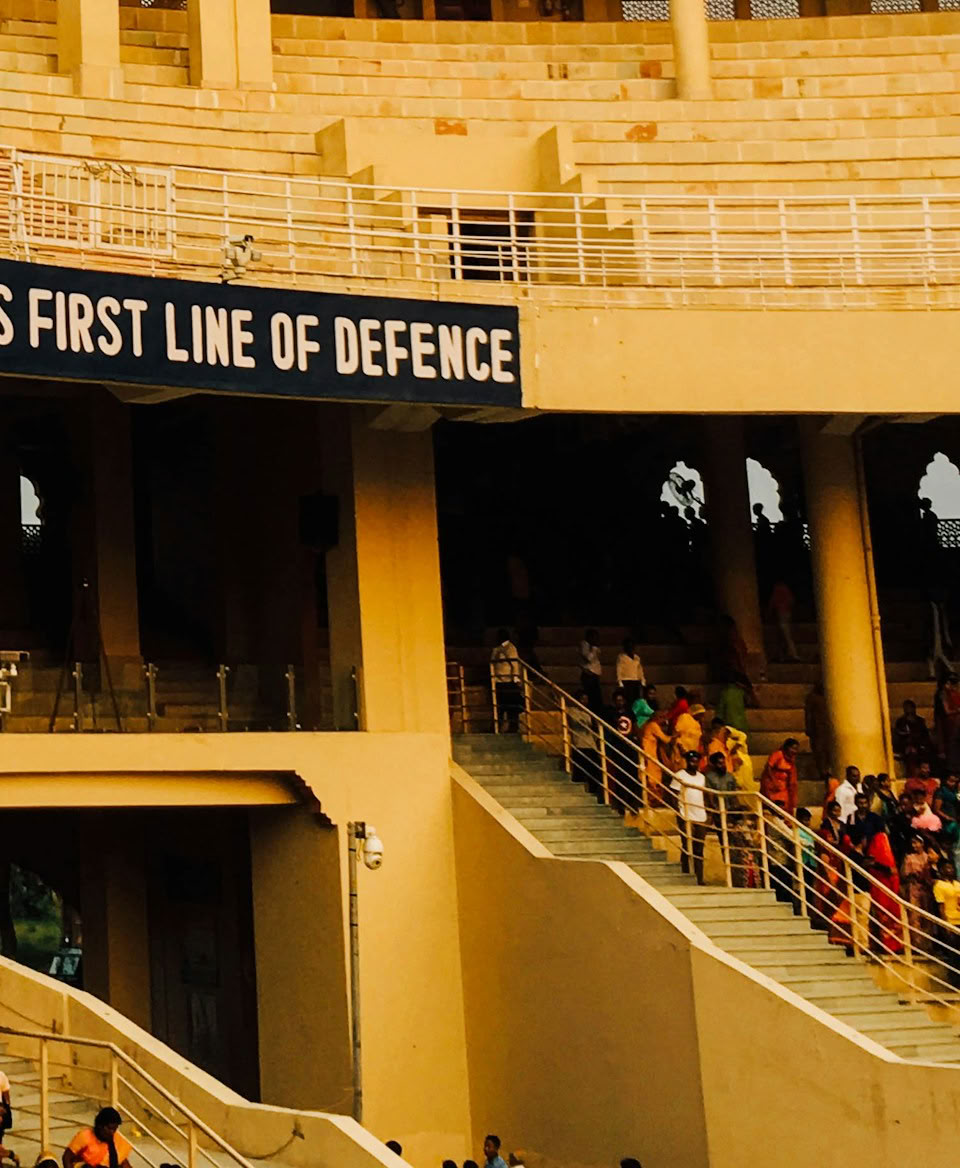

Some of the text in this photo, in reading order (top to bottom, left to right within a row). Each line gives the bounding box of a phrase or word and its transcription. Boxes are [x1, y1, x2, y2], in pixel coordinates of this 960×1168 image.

[27, 288, 148, 357] FIRST
[165, 301, 256, 368] LINE
[270, 312, 320, 372] OF
[334, 316, 515, 383] DEFENCE
